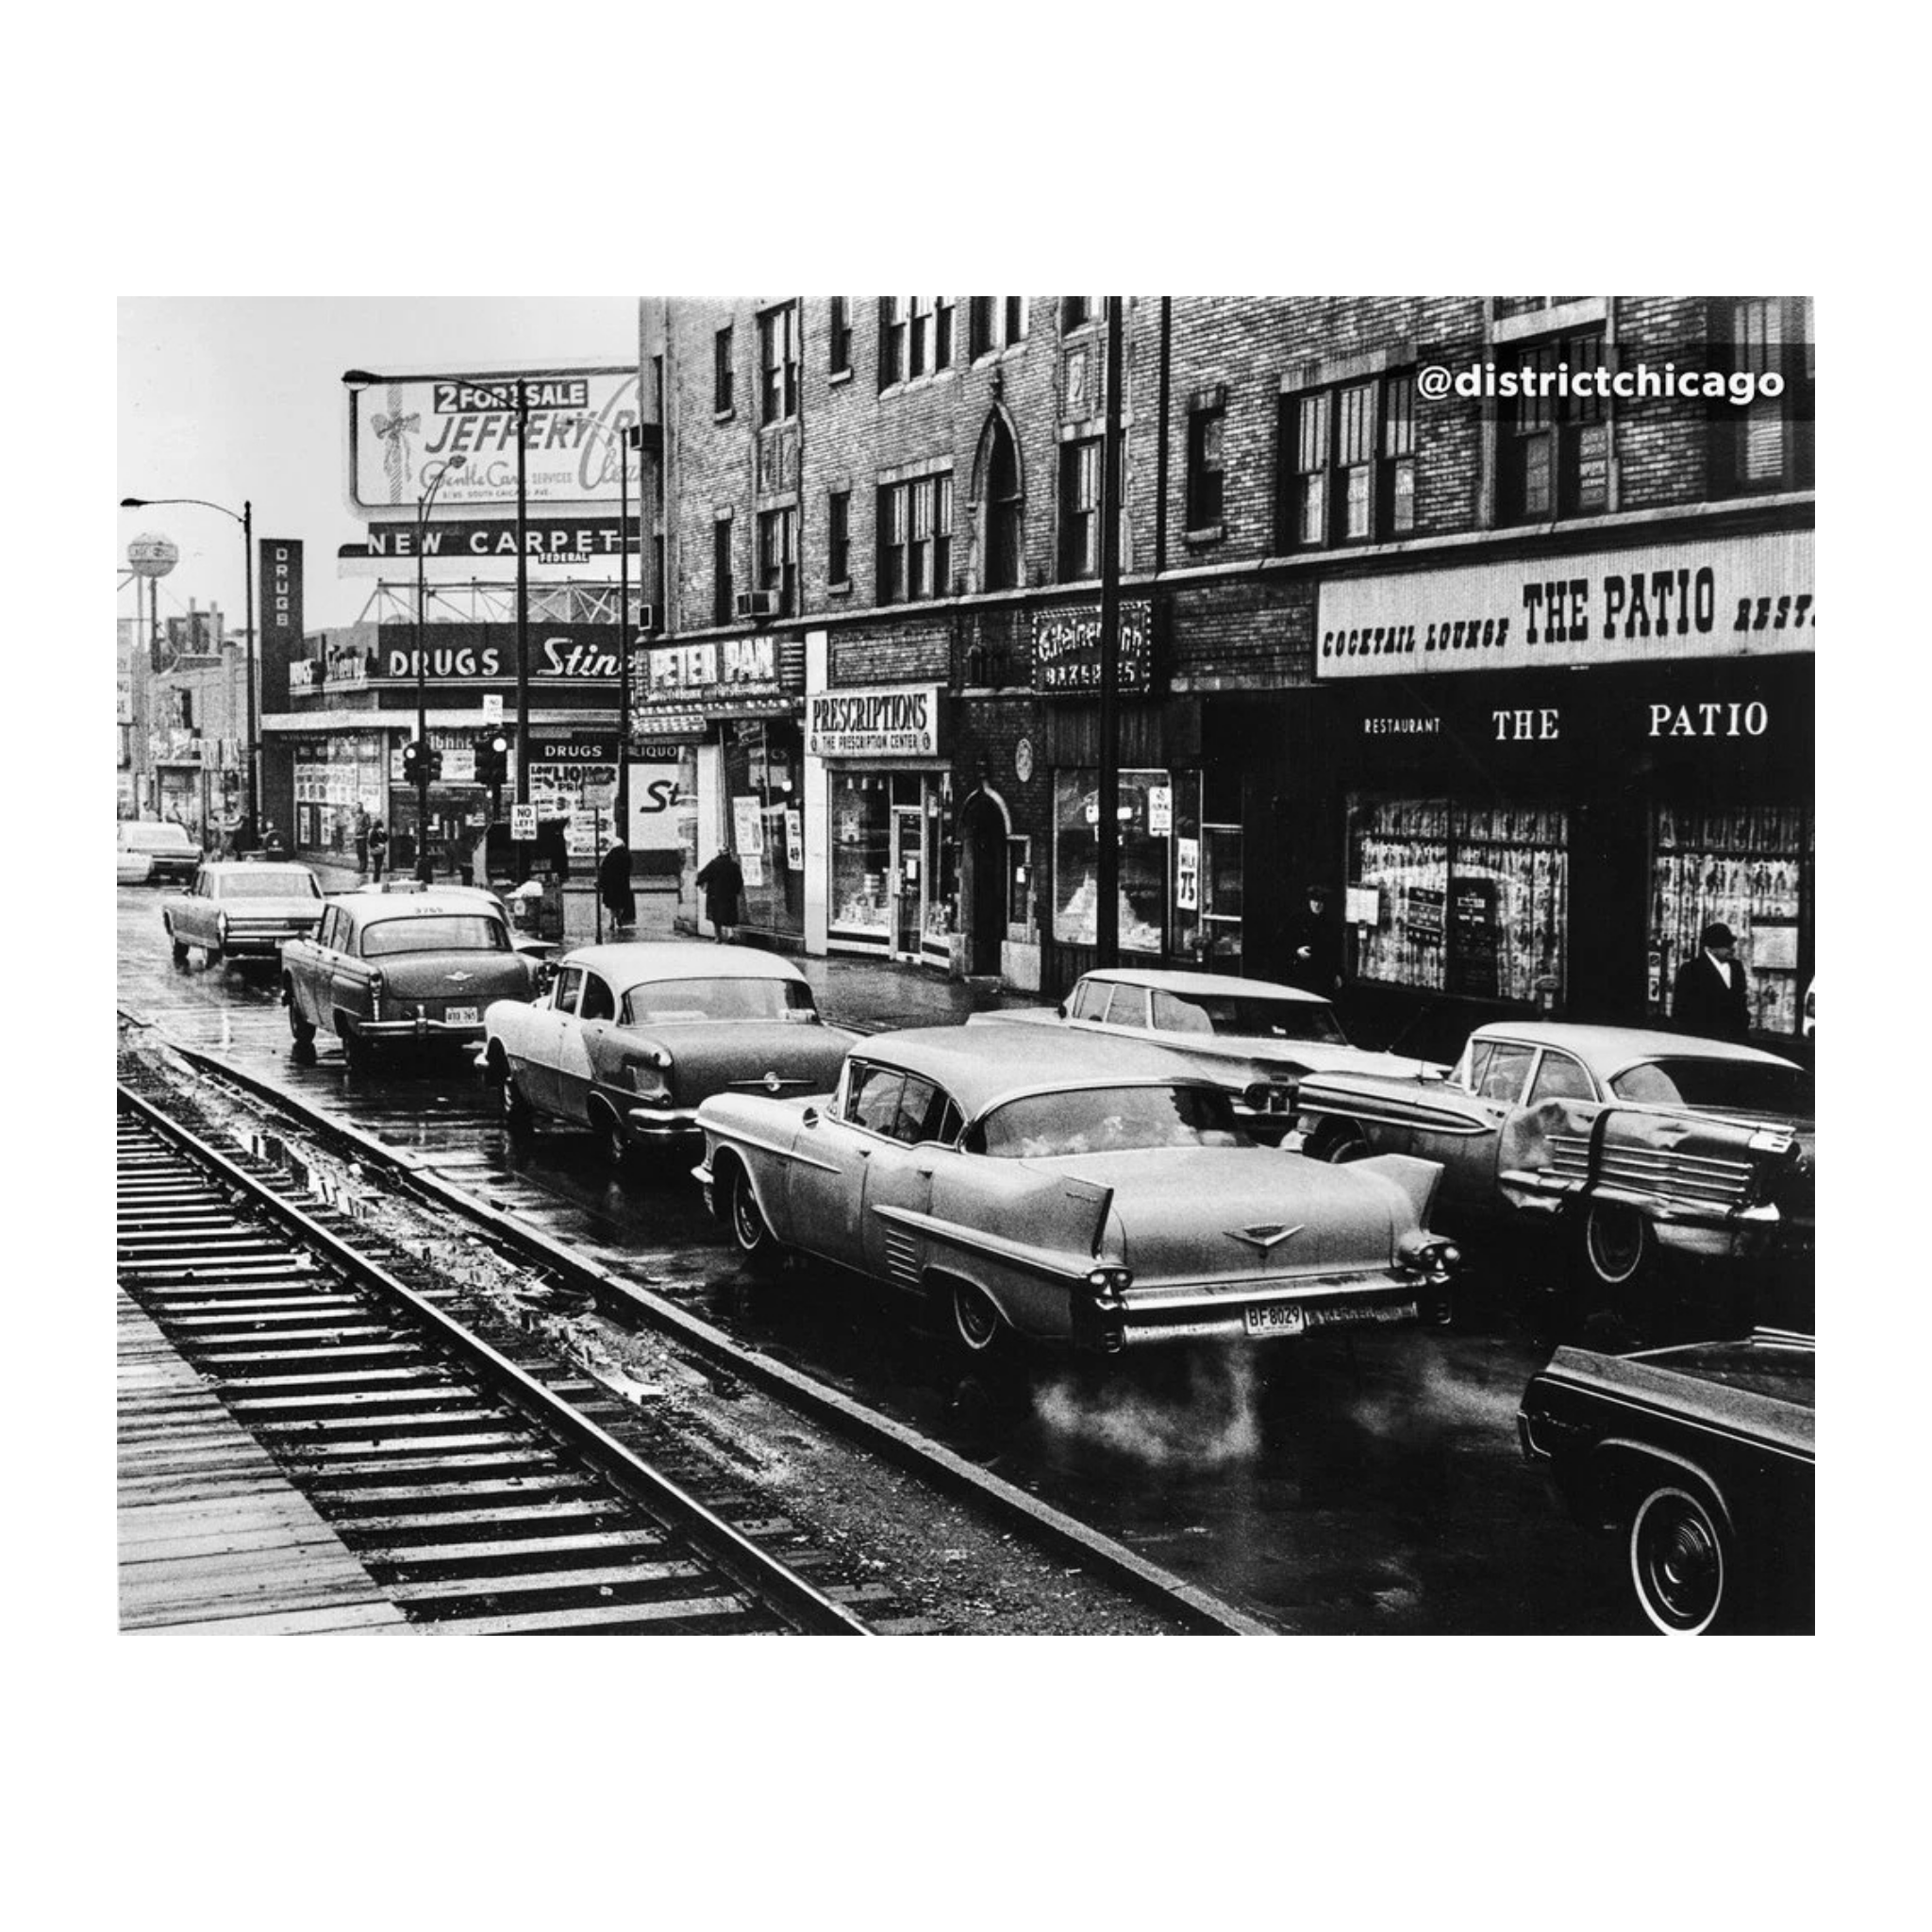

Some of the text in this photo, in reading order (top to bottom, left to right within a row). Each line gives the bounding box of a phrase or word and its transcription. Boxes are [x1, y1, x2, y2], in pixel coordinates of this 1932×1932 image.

[438, 386, 458, 412] 2
[459, 384, 508, 409] FOR
[525, 382, 586, 407] SALE
[425, 410, 598, 453] JEFFERY
[367, 529, 618, 555] NEW CARPET
[539, 552, 589, 563] FEDERAL
[276, 547, 289, 626] DRUGS
[1523, 566, 1715, 645] THE PATIO
[1323, 618, 1509, 658] COCKTAIL LOUNGE
[389, 647, 500, 677] DRUGS
[812, 692, 927, 733] PRESCRIPTIONS
[1364, 717, 1441, 734] RESTAURANT
[1492, 701, 1769, 741] THE PATIO
[544, 744, 602, 758] DRUGS
[823, 733, 918, 750] THE PRESCRIPTION CENTER
[514, 819, 534, 827] LEFT
[517, 807, 532, 818] NO
